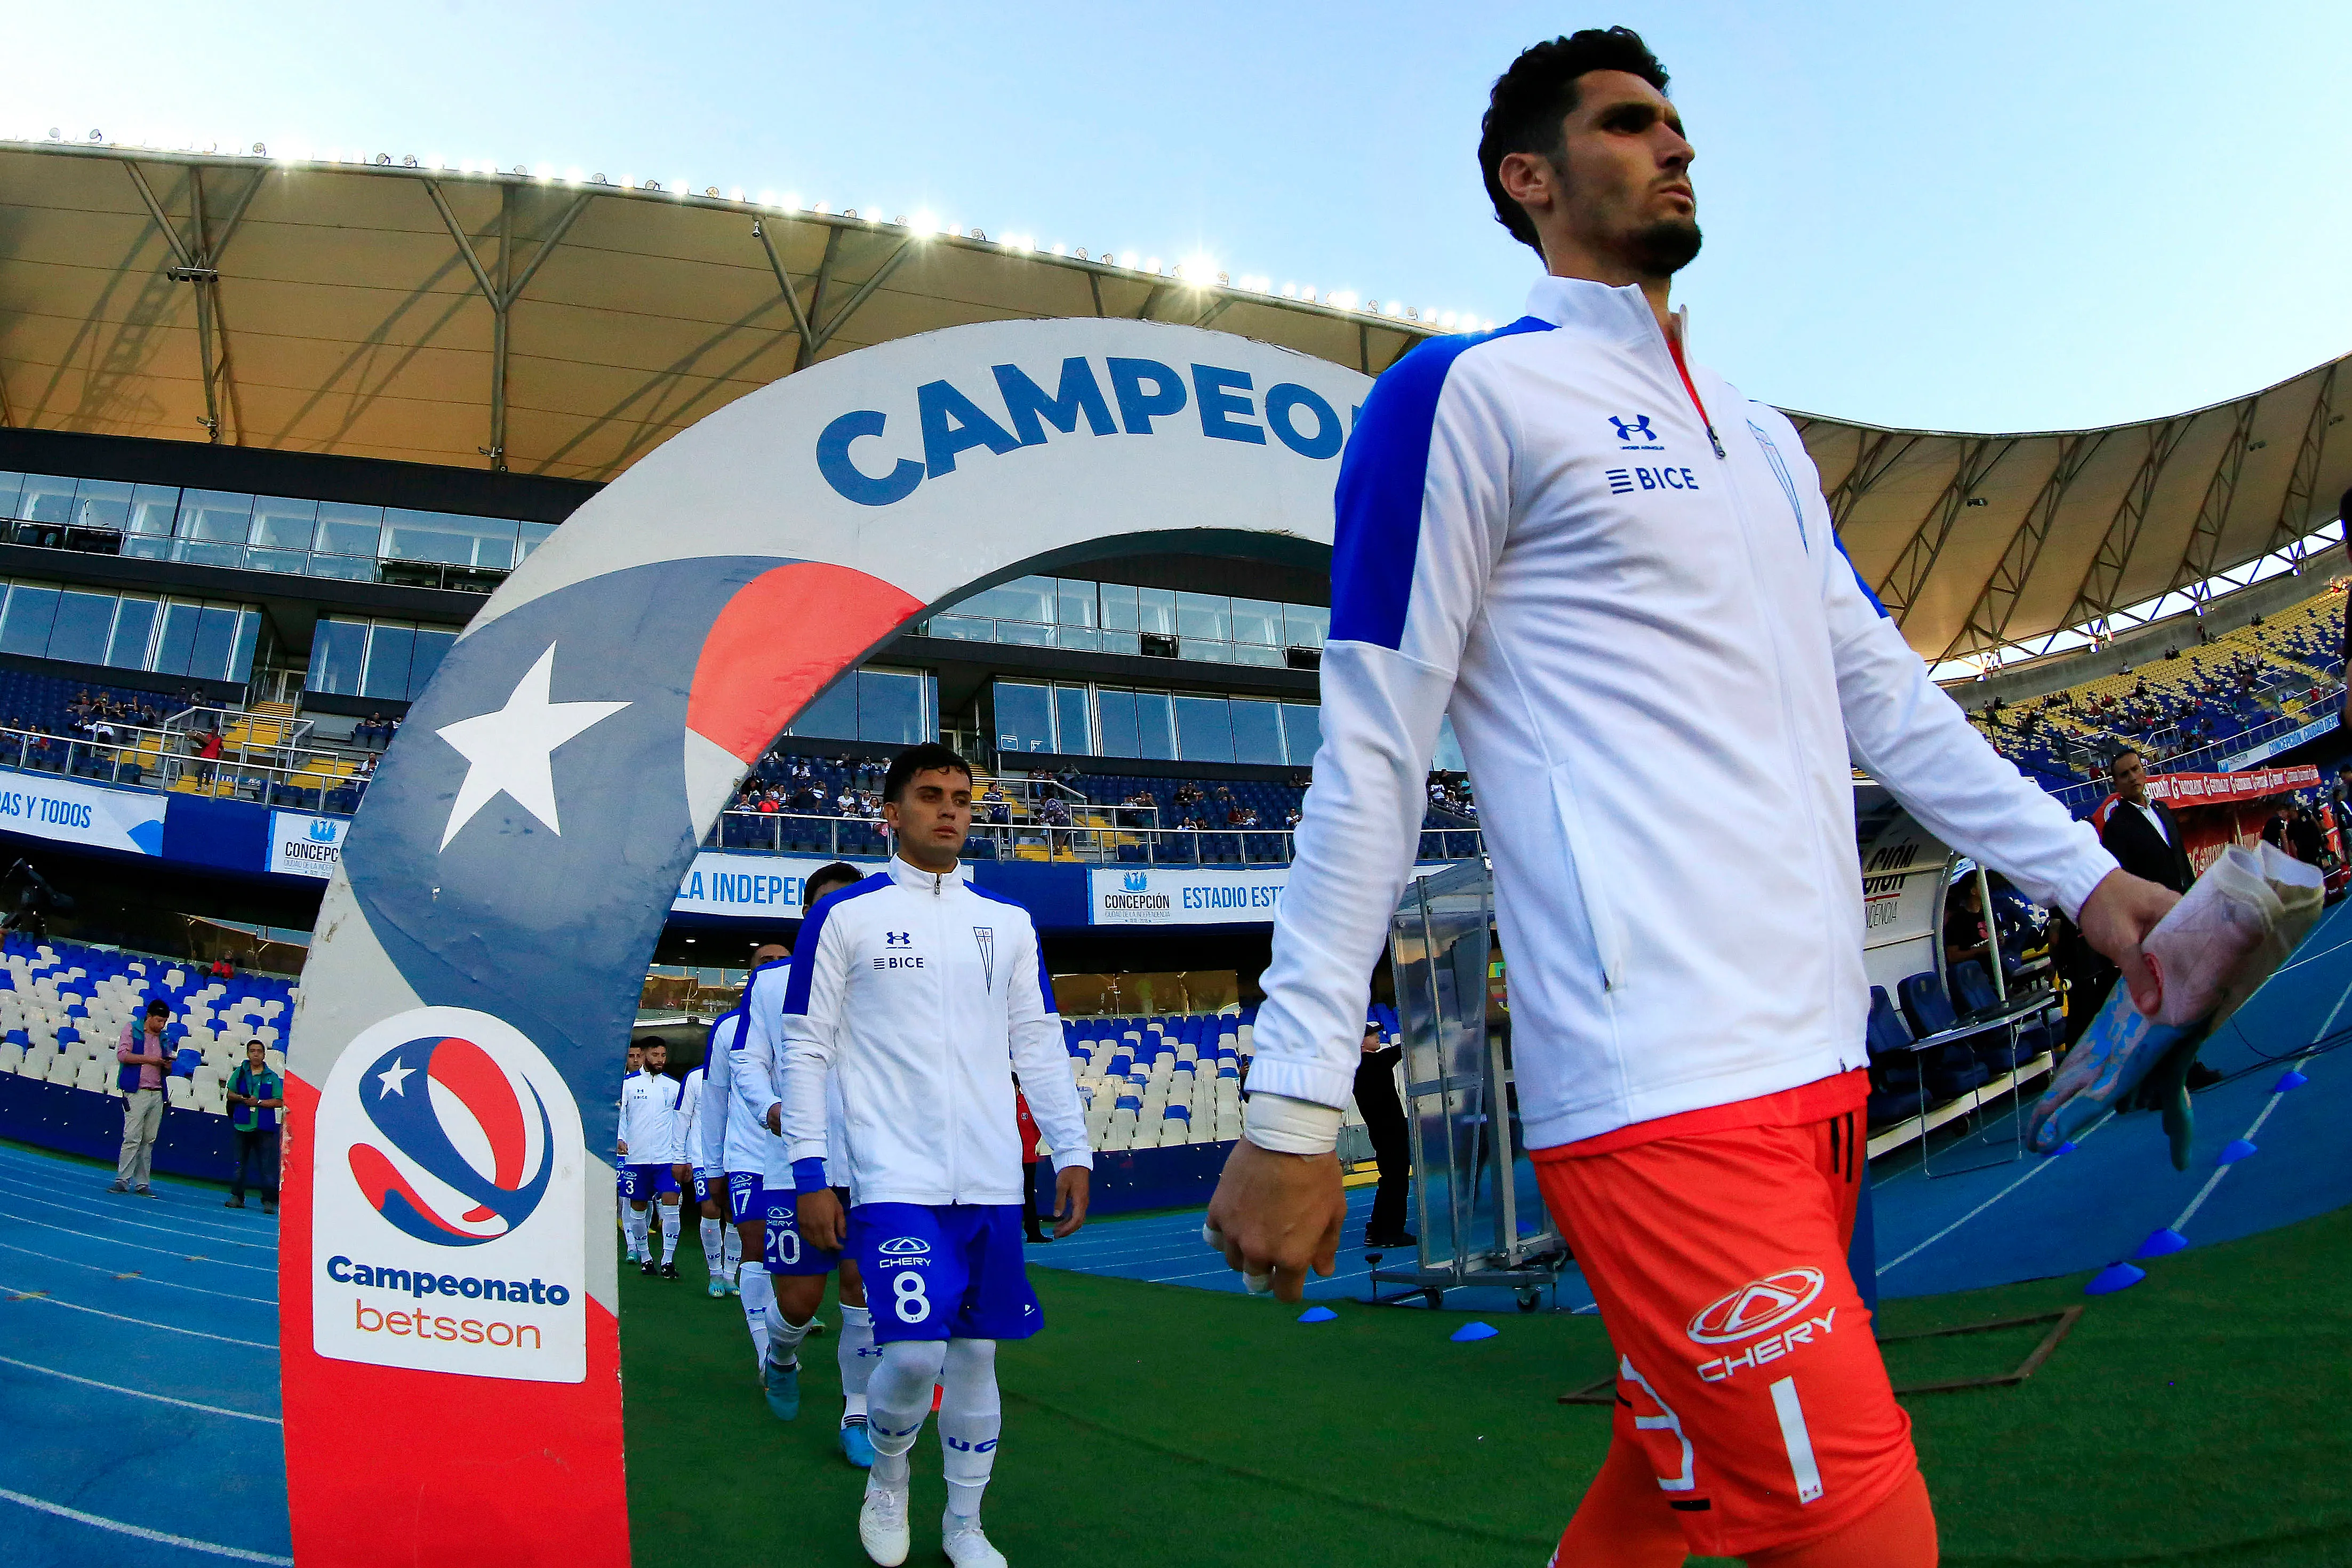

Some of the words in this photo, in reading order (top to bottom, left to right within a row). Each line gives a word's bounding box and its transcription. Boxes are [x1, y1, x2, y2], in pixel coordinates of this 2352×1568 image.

[816, 356, 1361, 506] CAMPEO
[1635, 467, 1699, 490] BICE
[0, 790, 22, 817] AS
[27, 795, 37, 819] Y
[41, 798, 92, 828] TODOS
[285, 842, 339, 862] CONCEPC
[1105, 893, 1170, 909] CONCEPCIÓN
[1182, 887, 1247, 909] ESTADIO
[1251, 886, 1285, 908] EST
[889, 957, 924, 969] BICE
[626, 1180, 634, 1195] 3
[732, 1188, 751, 1217] 17
[766, 1228, 800, 1265] 20
[879, 1257, 932, 1268] CHERY
[326, 1255, 570, 1306] Campeonato
[893, 1270, 931, 1324] 8
[356, 1298, 541, 1349] betsson
[1697, 1306, 1837, 1383] CHERY
[948, 1436, 997, 1453] UC
